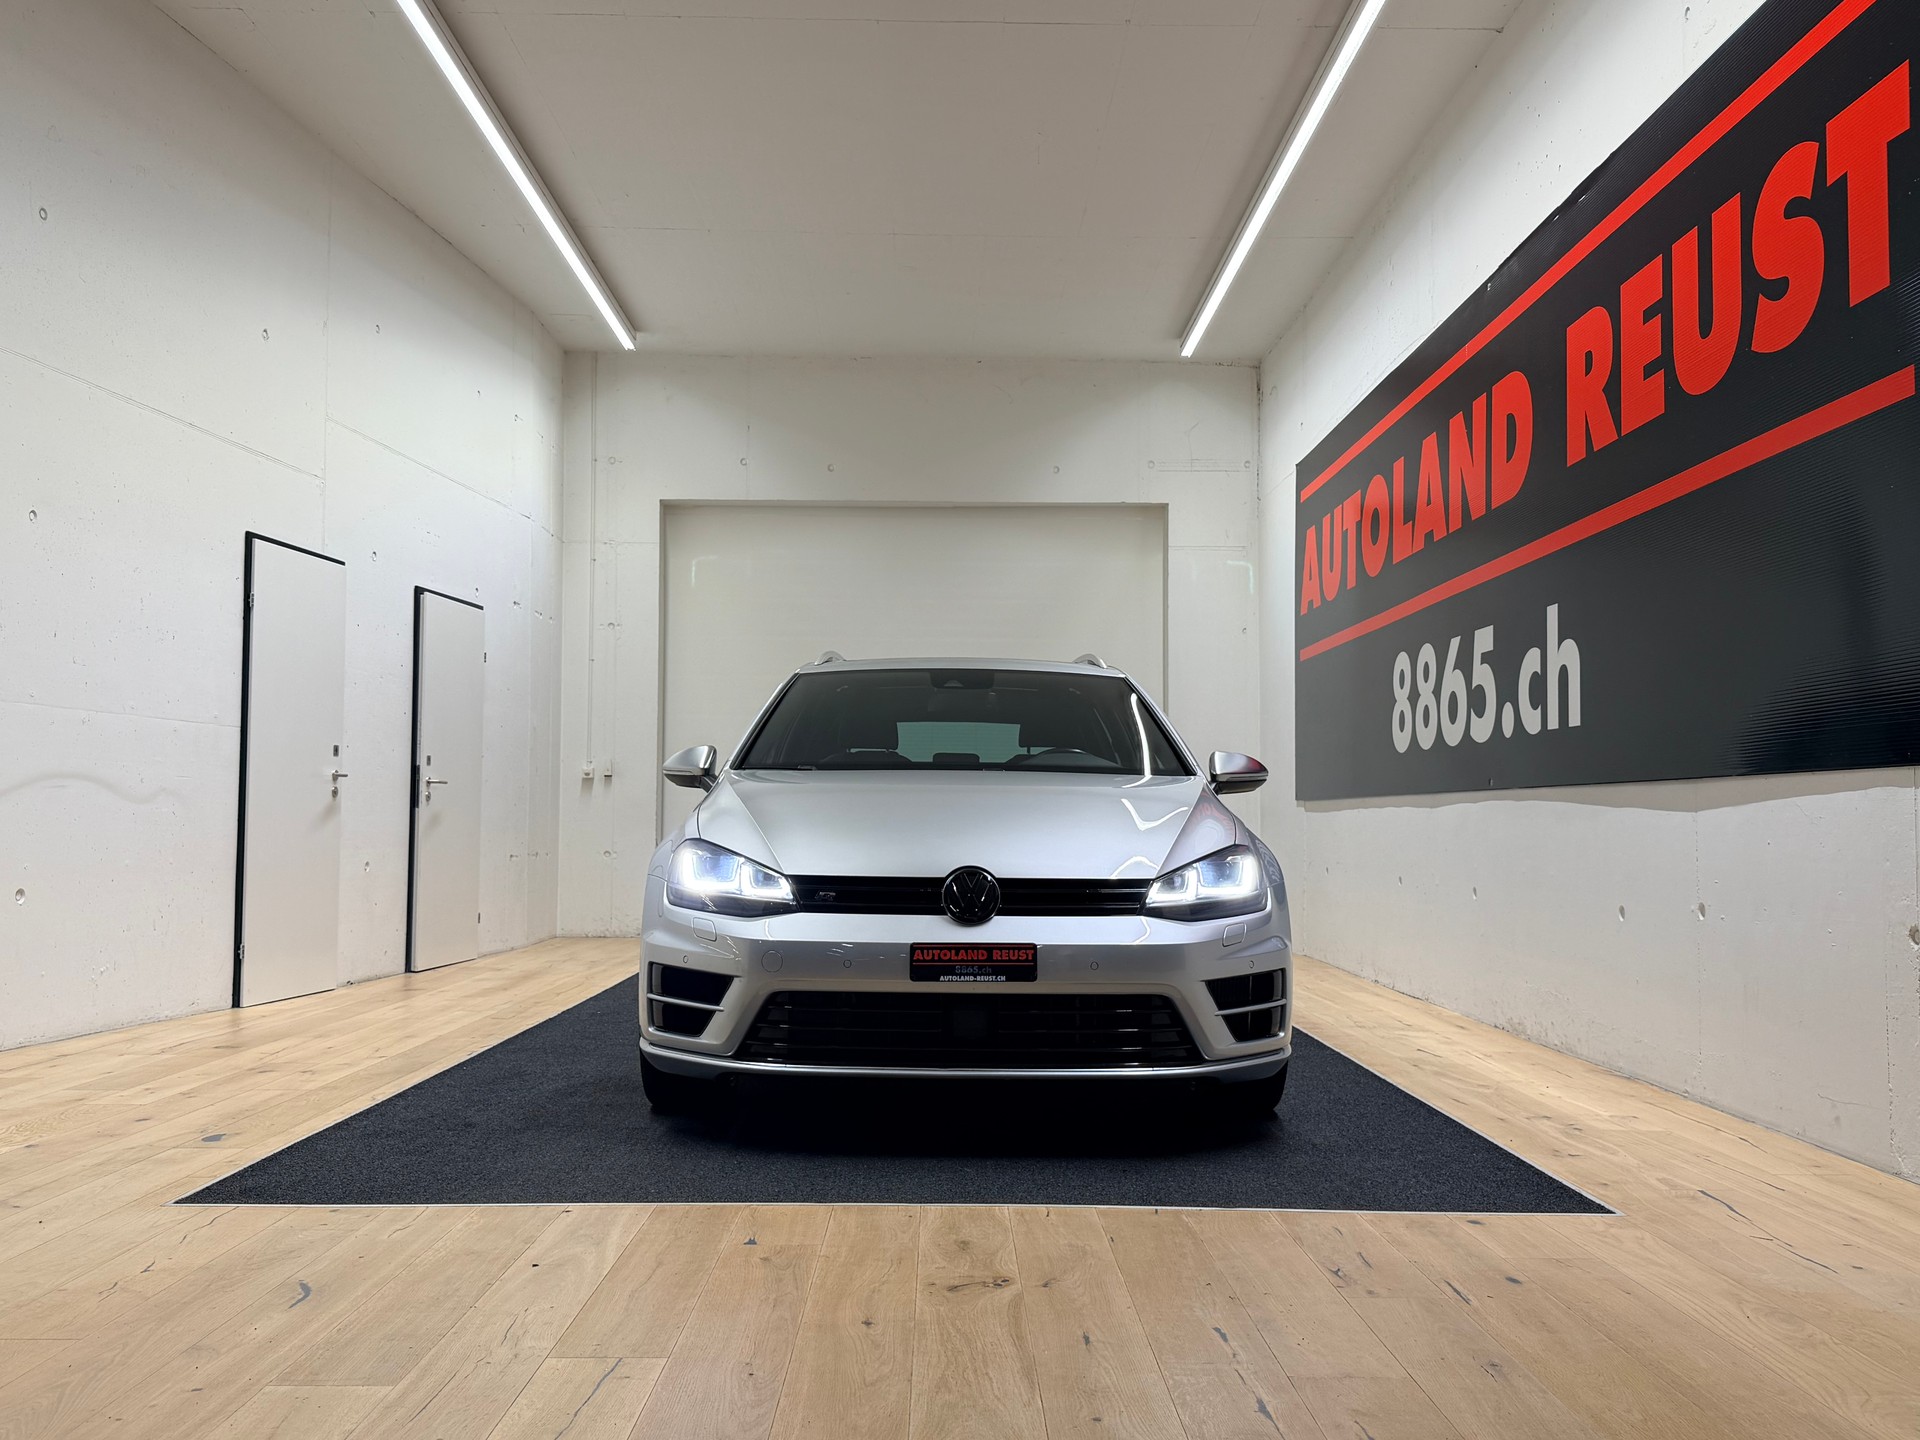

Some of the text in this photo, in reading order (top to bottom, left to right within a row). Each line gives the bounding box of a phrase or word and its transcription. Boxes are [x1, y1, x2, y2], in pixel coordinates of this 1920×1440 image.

[1300, 59, 1910, 616] AUTOLAND REUST
[1391, 603, 1581, 754] 8865.ch
[943, 867, 1000, 922] VW
[913, 949, 1035, 960] AUTOLAND REUST
[955, 965, 992, 974] 8865.ch
